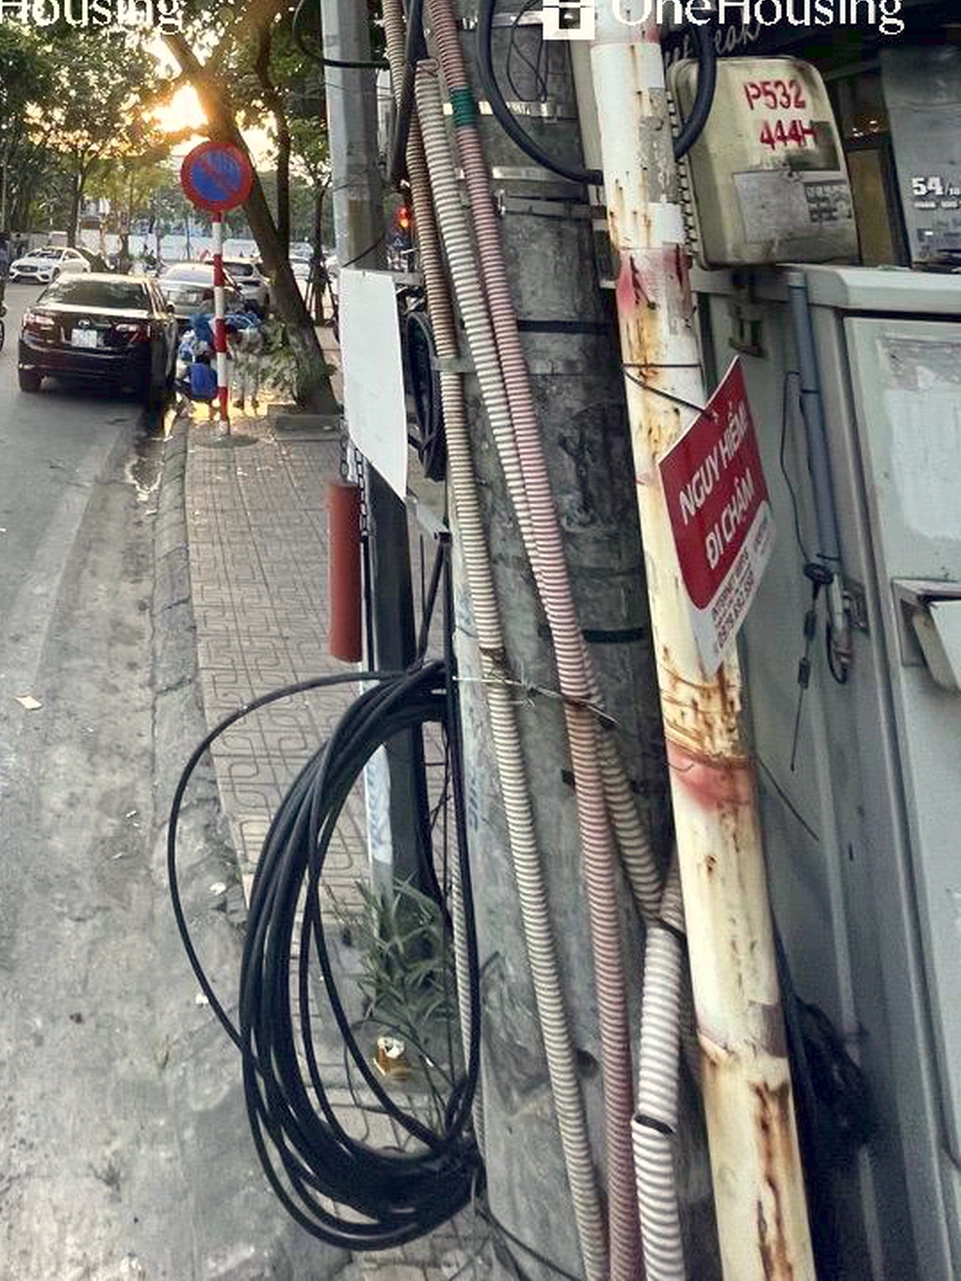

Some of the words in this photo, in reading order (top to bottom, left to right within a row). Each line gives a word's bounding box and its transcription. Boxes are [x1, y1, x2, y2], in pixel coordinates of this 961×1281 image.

[744, 80, 806, 110] P532
[679, 444, 721, 525] NGUY
[705, 523, 724, 570] ĐI
